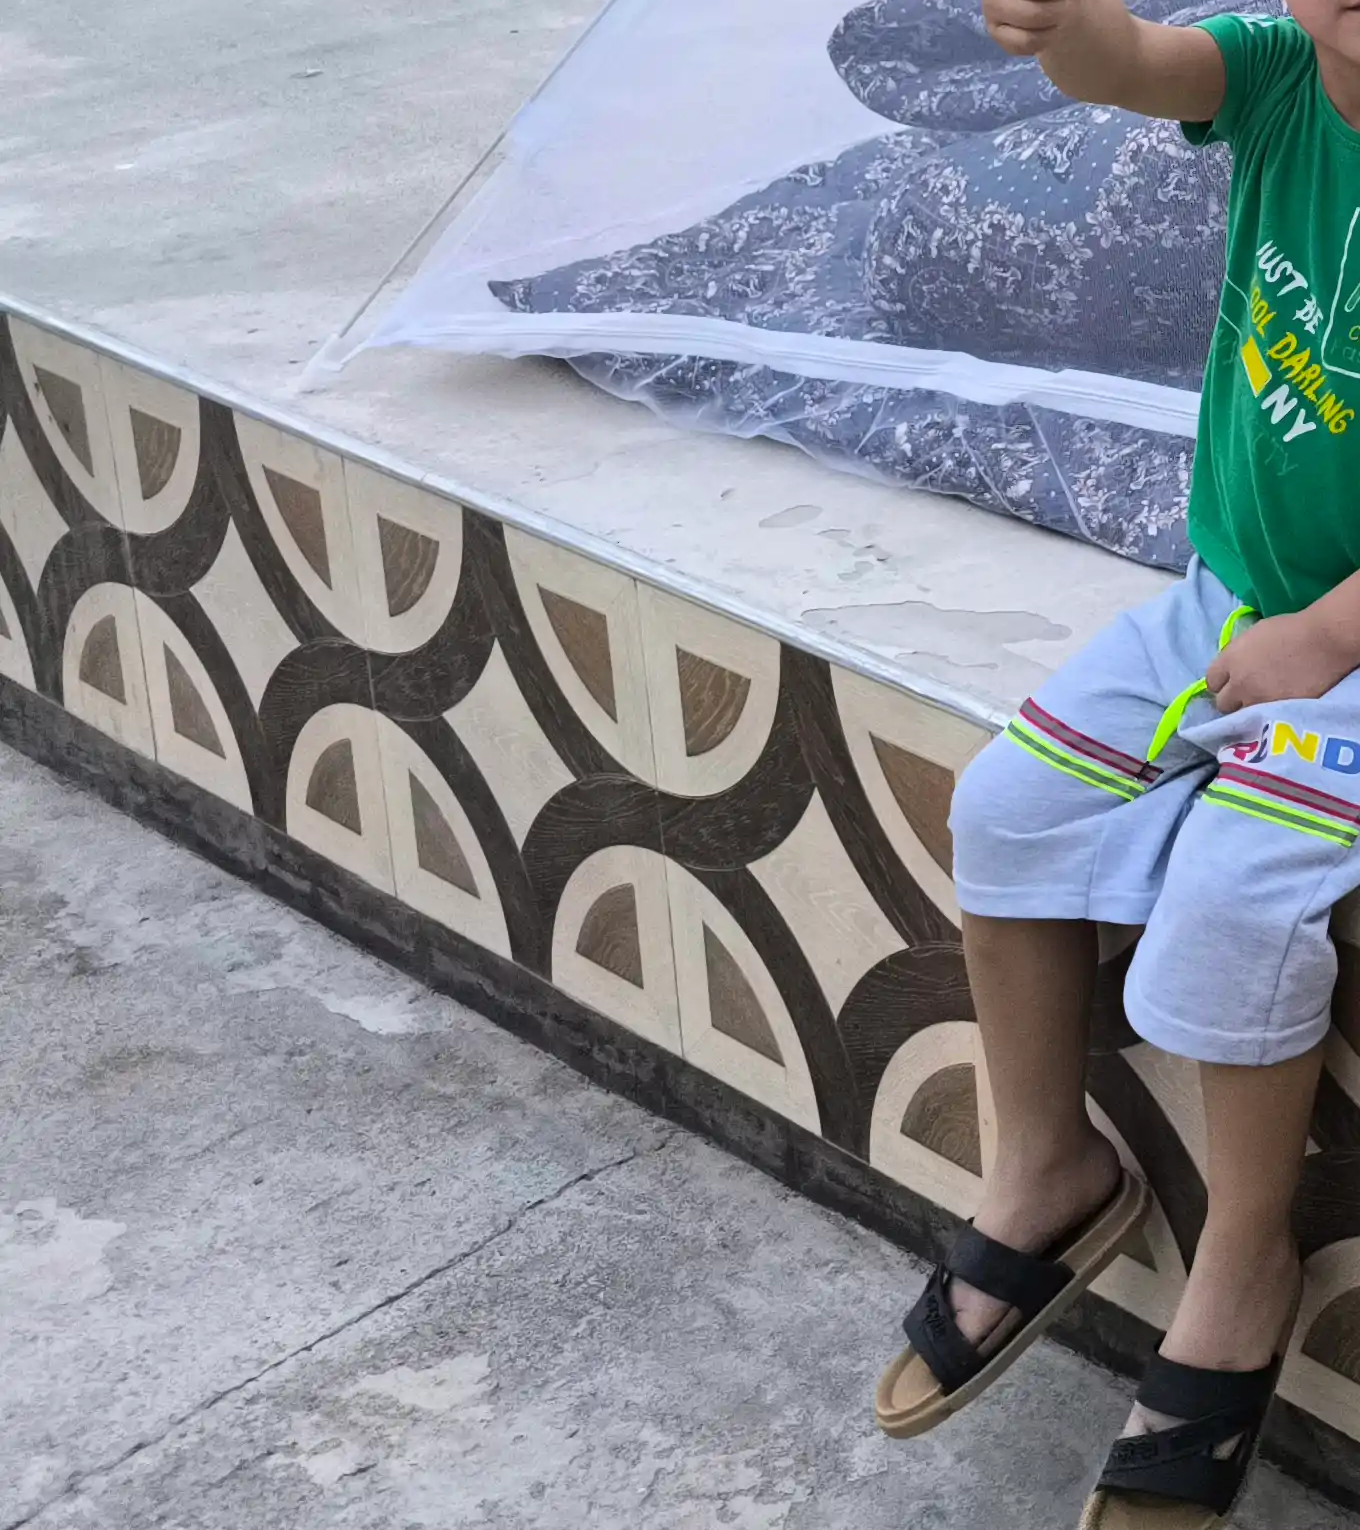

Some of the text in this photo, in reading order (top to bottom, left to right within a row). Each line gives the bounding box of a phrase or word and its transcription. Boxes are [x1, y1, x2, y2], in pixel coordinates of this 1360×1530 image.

[1292, 292, 1324, 335] BE
[1250, 278, 1356, 434] OOL DARLING
[1260, 383, 1317, 443] NY
